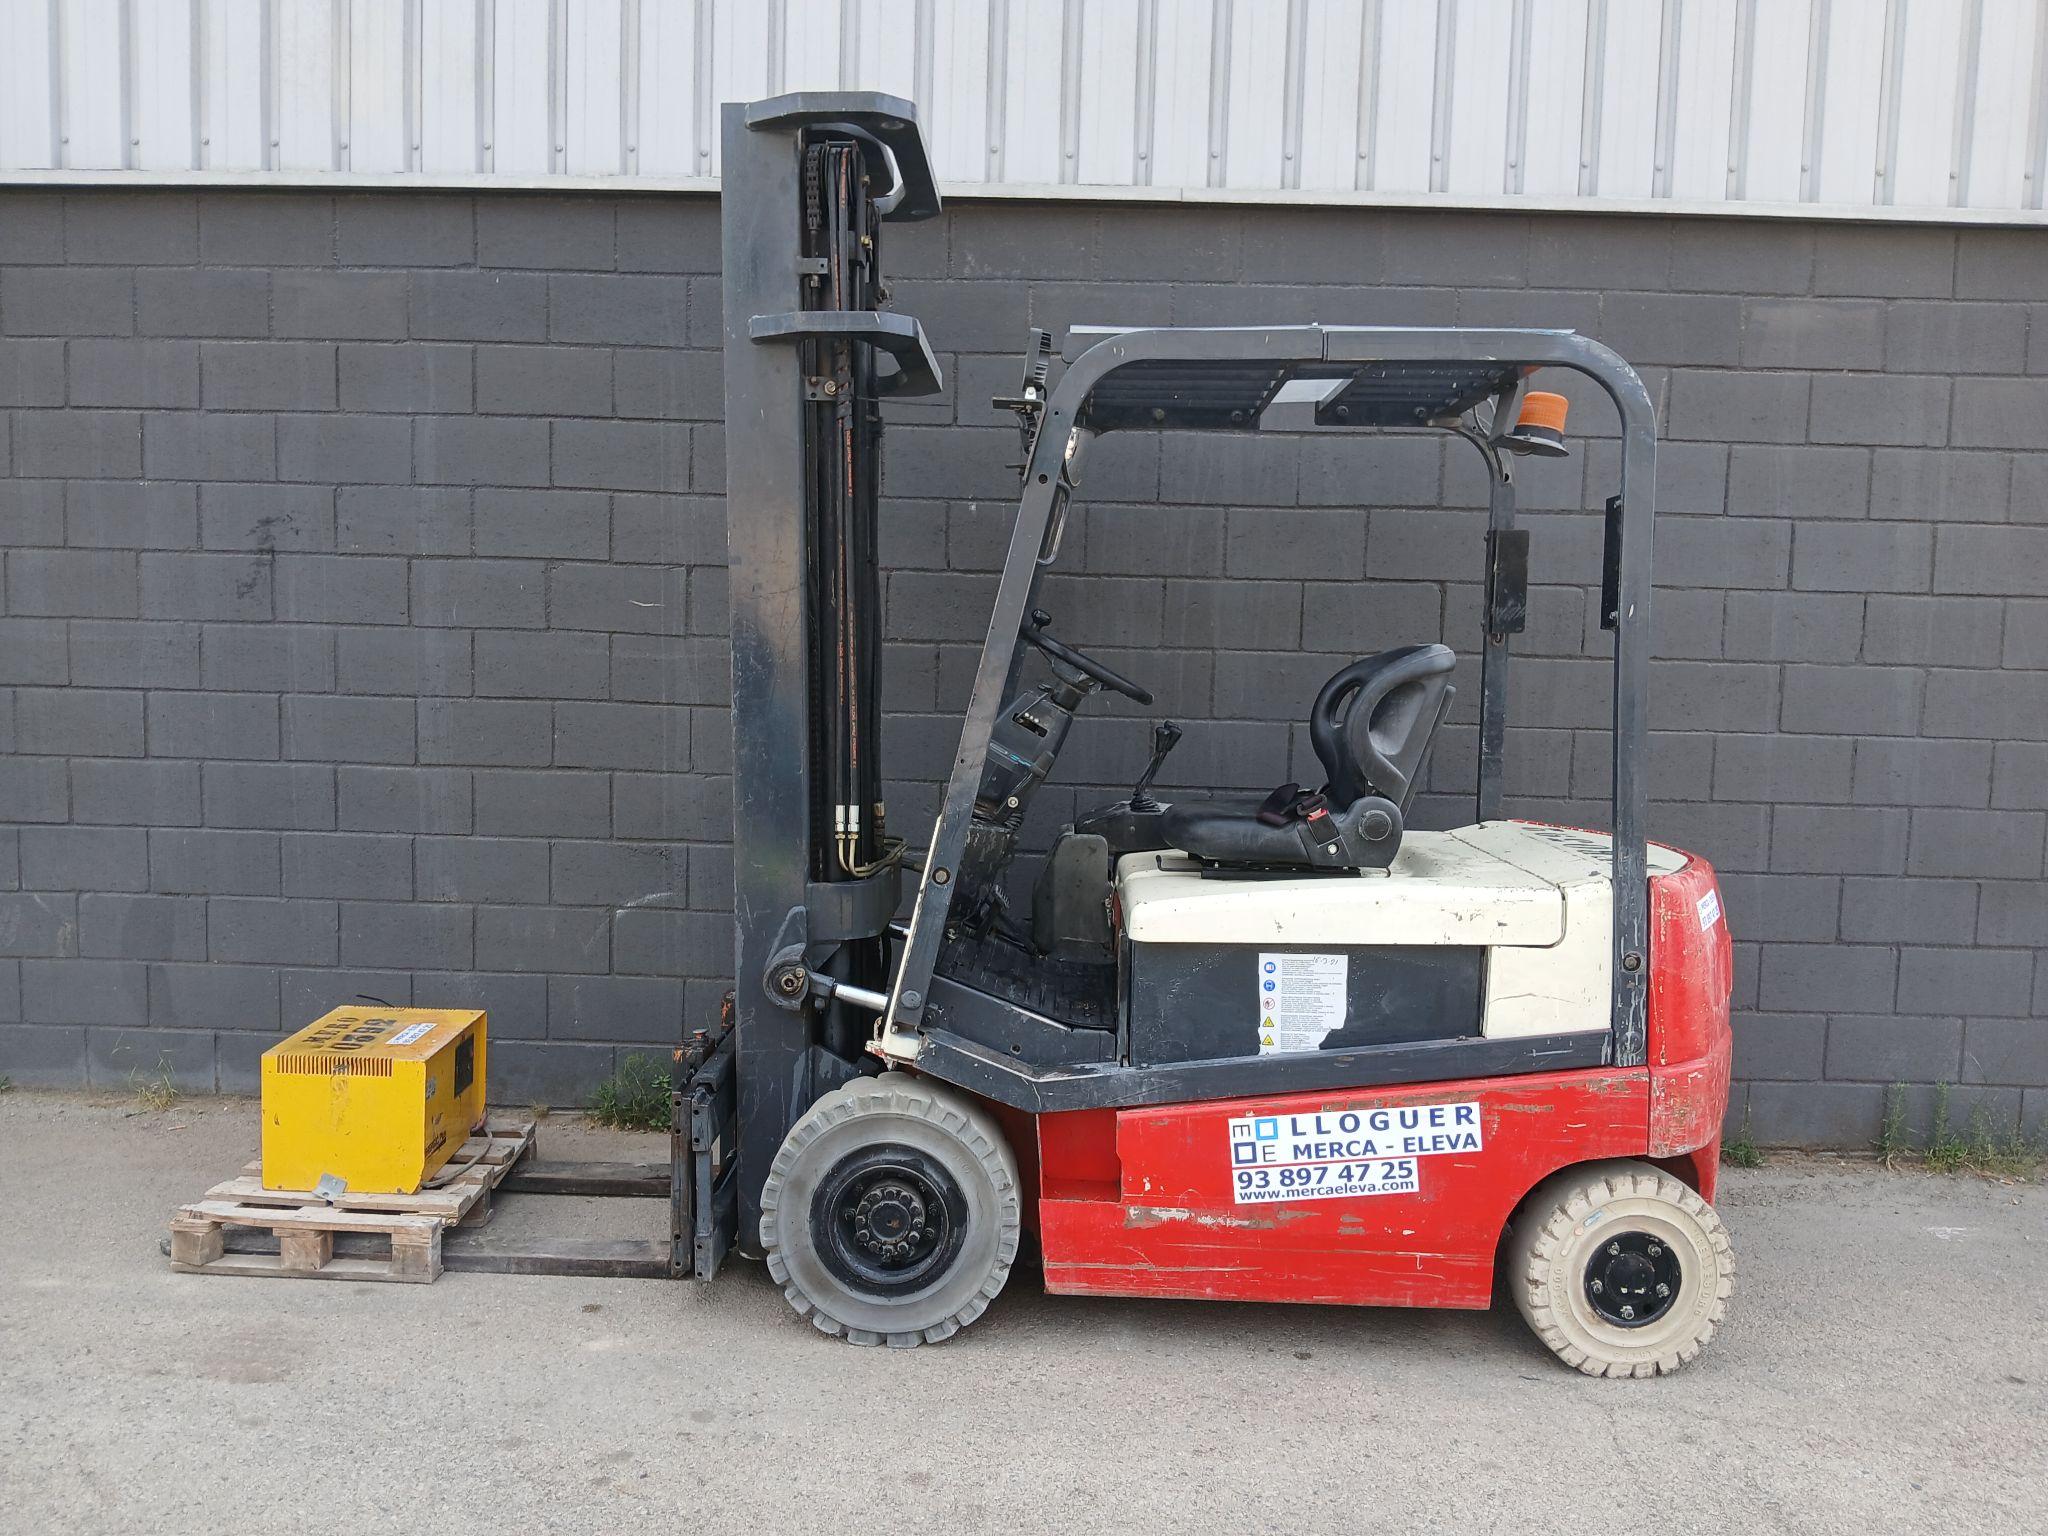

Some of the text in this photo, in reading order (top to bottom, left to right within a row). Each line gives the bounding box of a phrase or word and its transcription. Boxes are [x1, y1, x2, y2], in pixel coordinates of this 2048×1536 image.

[1291, 1105, 1476, 1137] LLOGUER
[1293, 1140, 1378, 1161] MERCA
[1403, 1132, 1479, 1153] ELEVA
[1237, 1160, 1413, 1190] 93 897 47 25
[1239, 1180, 1415, 1201] www.mercaeleva.com
